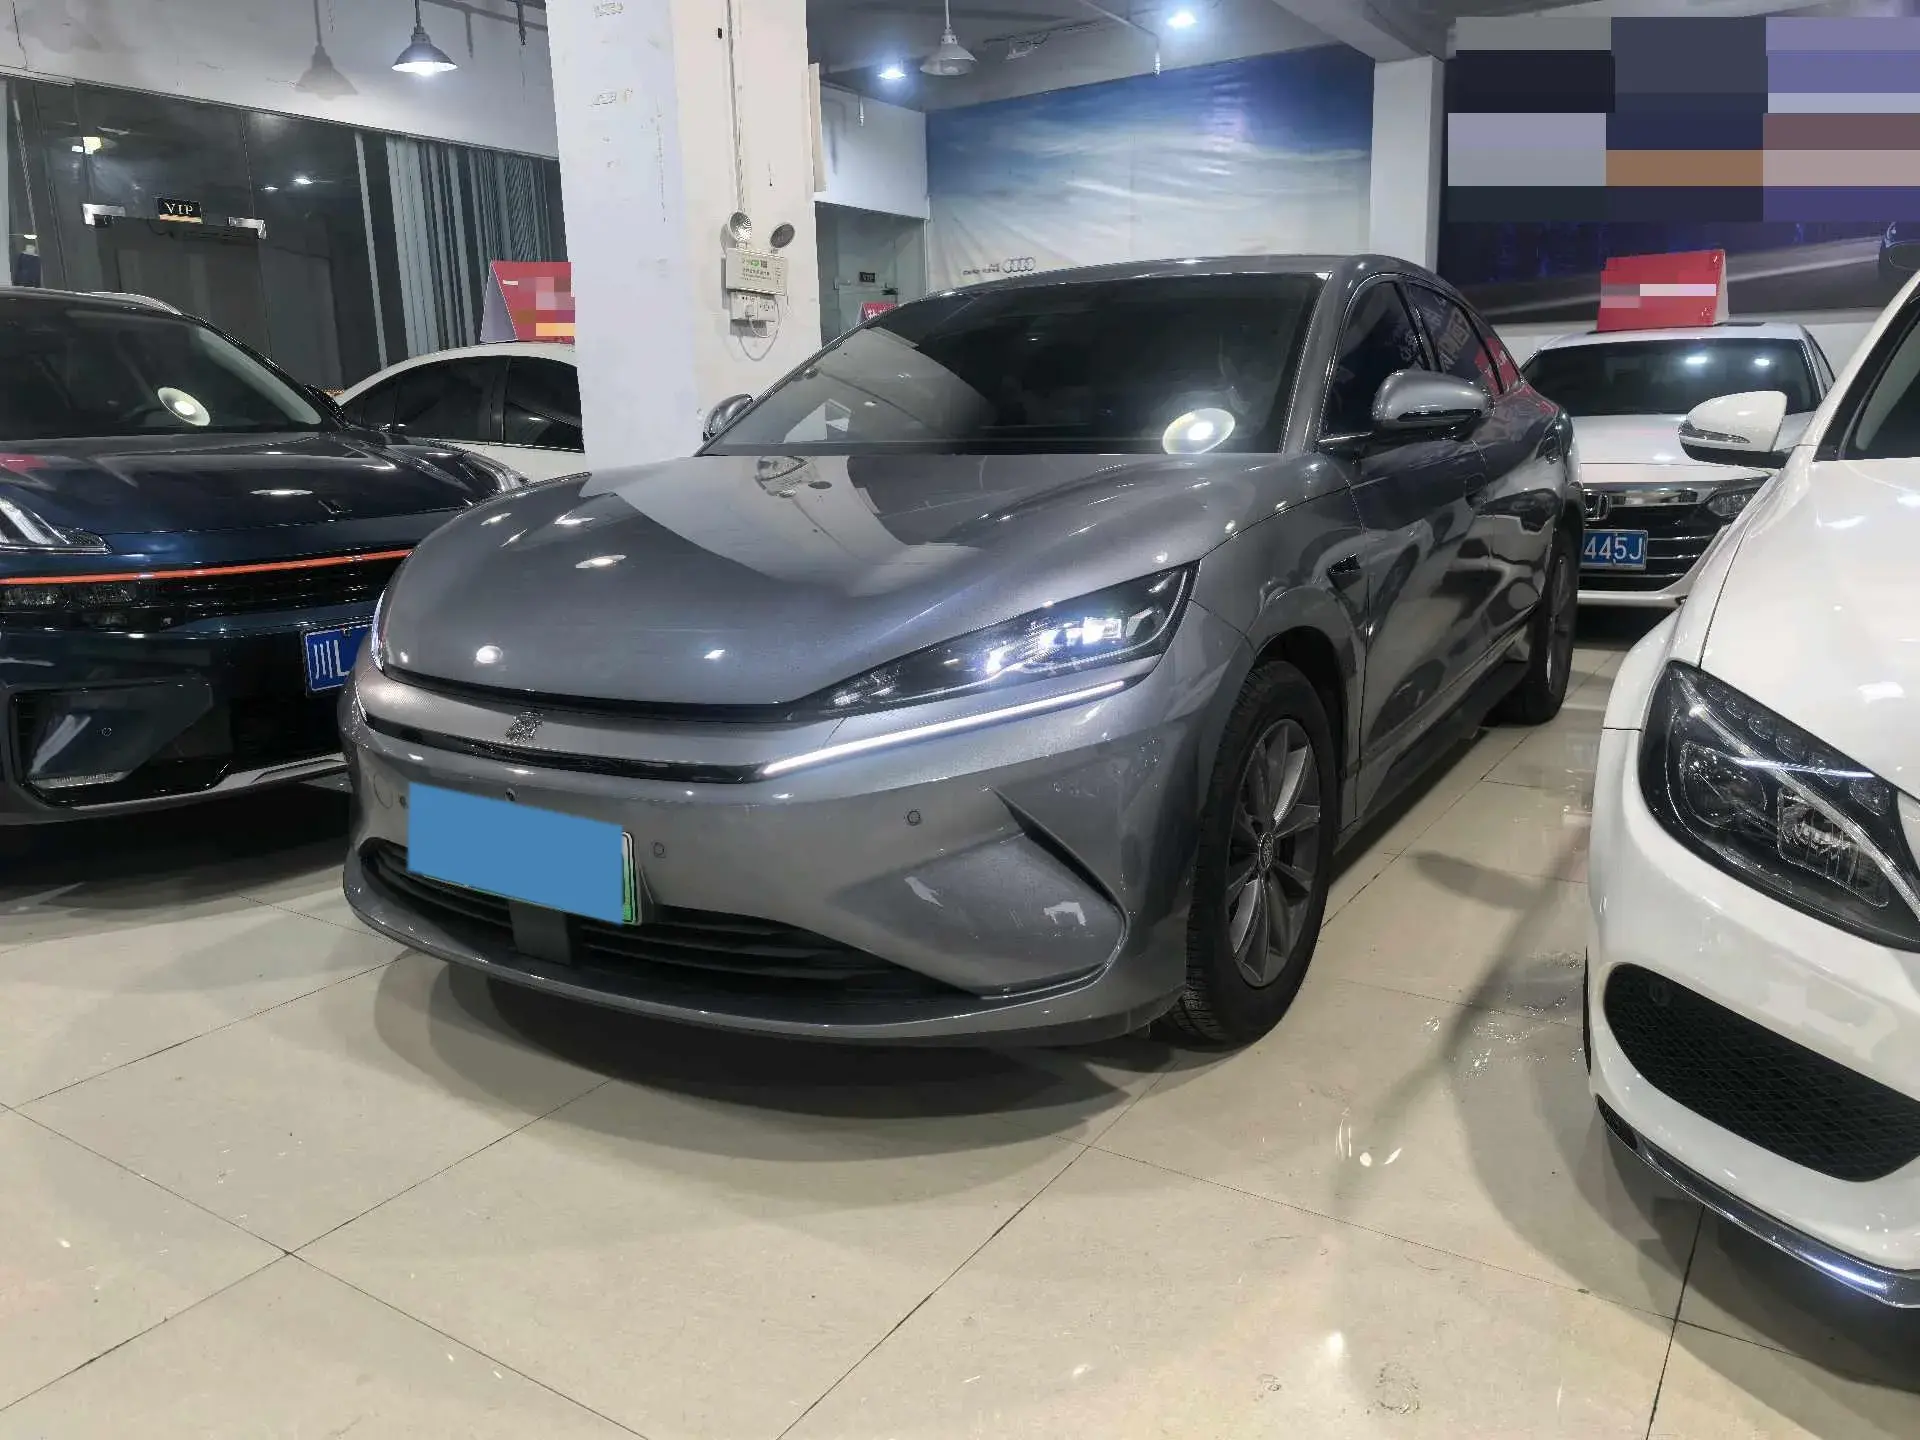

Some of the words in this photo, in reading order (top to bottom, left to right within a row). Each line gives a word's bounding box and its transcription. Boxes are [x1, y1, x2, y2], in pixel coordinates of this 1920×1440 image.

[164, 202, 193, 215] VIP
[1583, 536, 1643, 560] 445J
[313, 639, 351, 680] 川L
